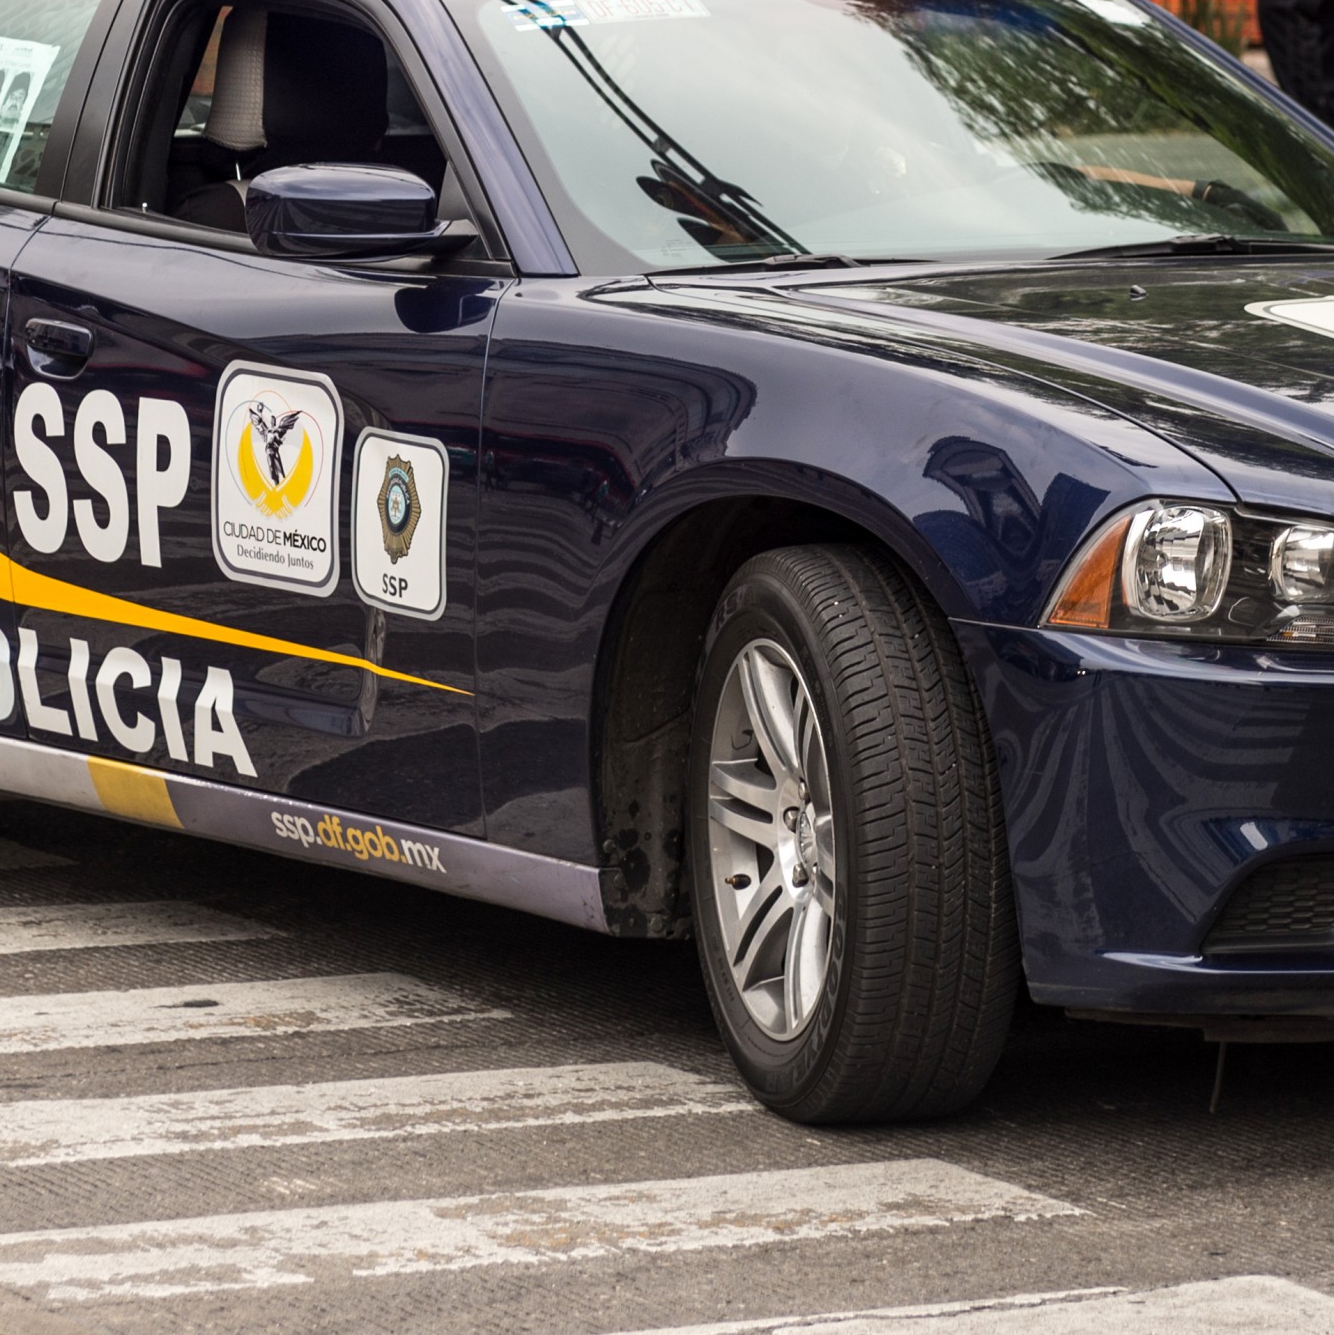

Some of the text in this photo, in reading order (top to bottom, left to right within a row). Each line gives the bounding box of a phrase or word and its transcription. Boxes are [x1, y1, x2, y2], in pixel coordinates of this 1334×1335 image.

[13, 381, 192, 568] SSP
[223, 521, 327, 553] CIUDAD DE MÉXICO
[237, 544, 315, 570] Decidiendo Juntos
[382, 573, 408, 598] SSP
[270, 812, 447, 873] ssp.df.gob.mx
